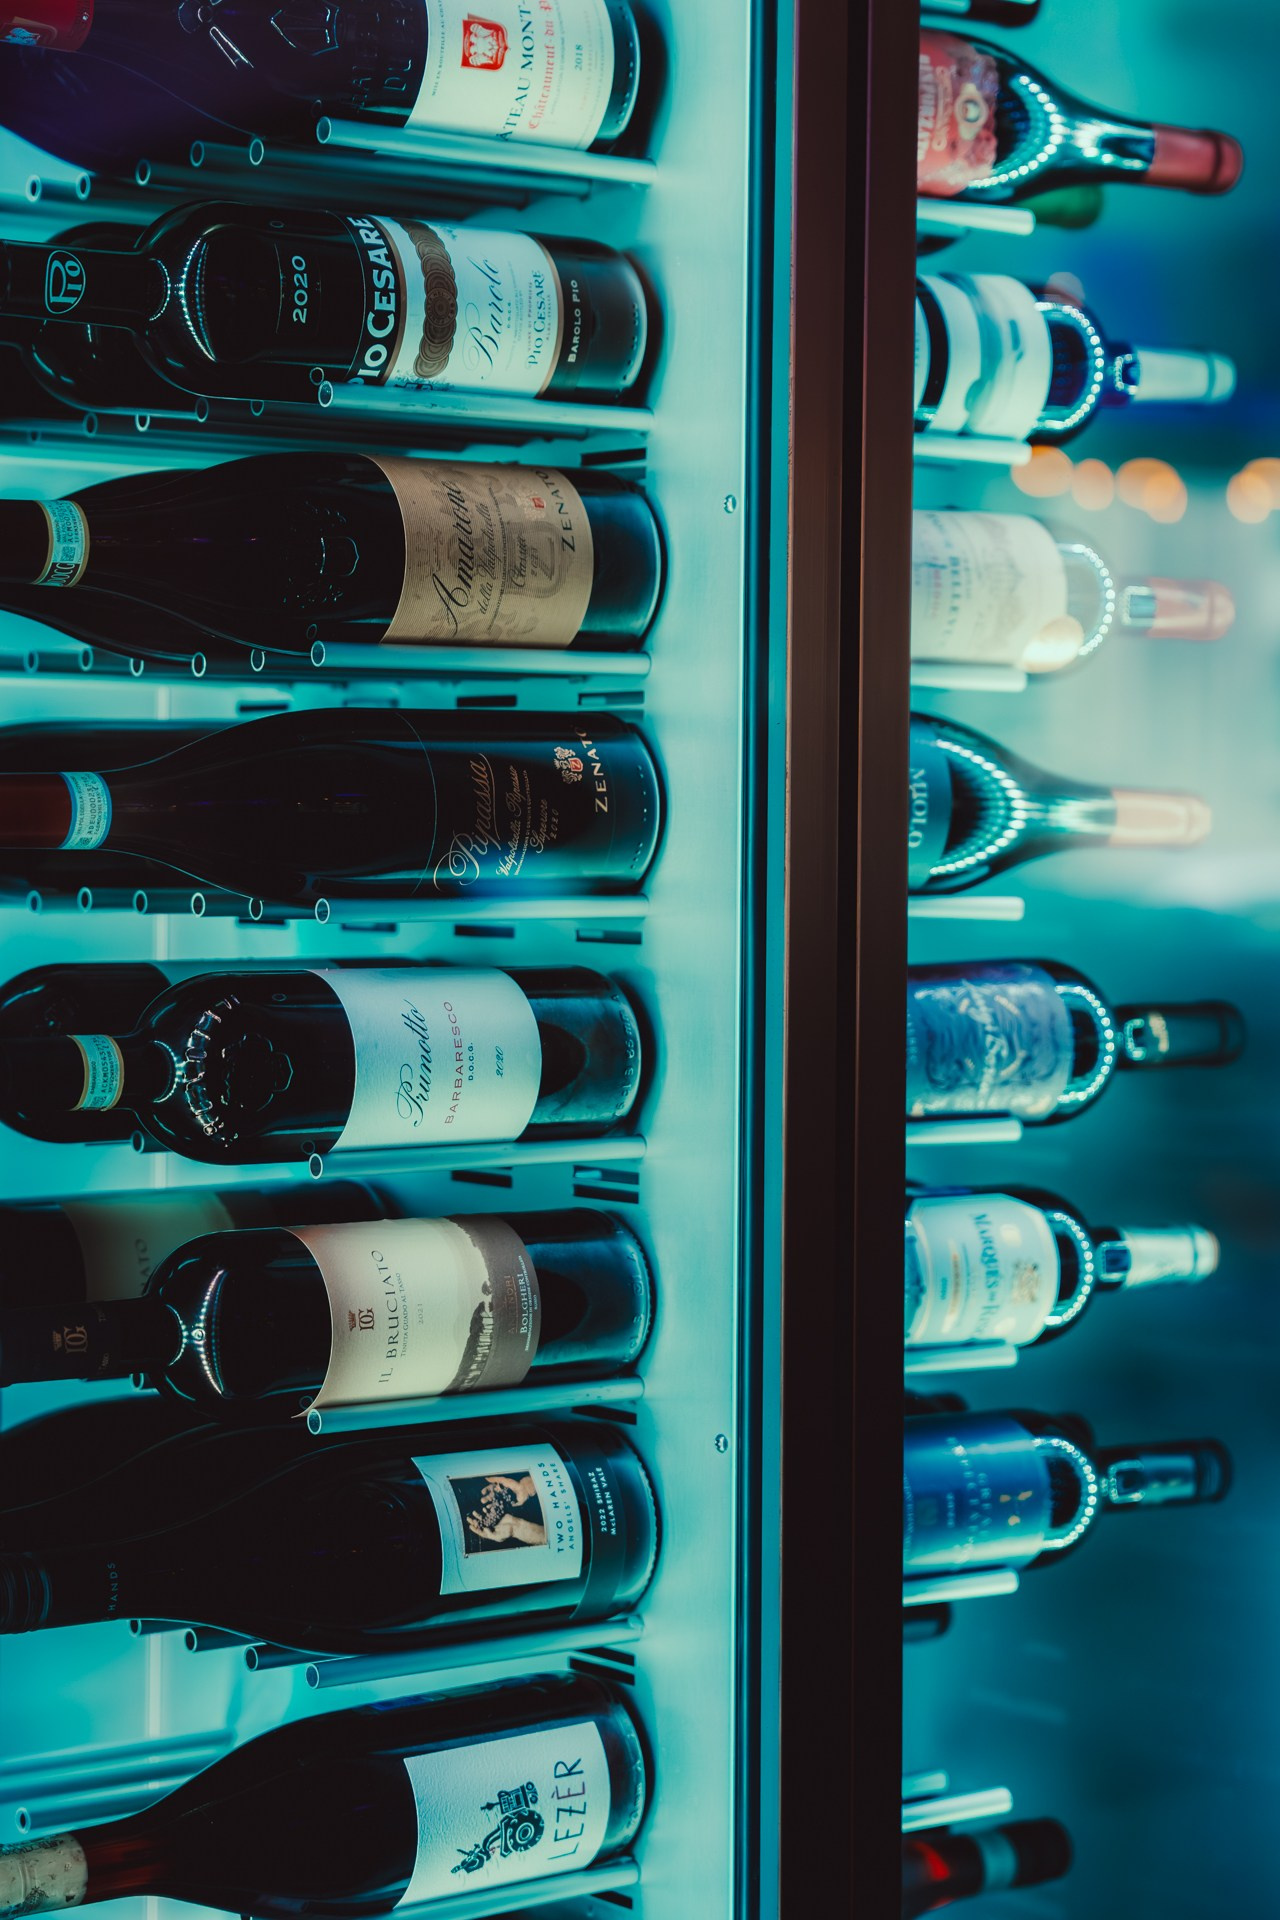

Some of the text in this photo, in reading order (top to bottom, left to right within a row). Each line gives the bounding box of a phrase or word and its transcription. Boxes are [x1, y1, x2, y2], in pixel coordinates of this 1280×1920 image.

[574, 43, 584, 71] 2018
[291, 255, 309, 324] 2020
[347, 217, 396, 338] CESARE
[462, 256, 503, 374] Barolo
[526, 270, 546, 367] PIO CESARE
[568, 279, 581, 363] BAROLO PIO
[535, 470, 575, 552] ZENATO
[432, 480, 474, 638] Amarone
[477, 583, 494, 614] della
[433, 753, 501, 891] Ripassa
[496, 765, 526, 876] Valpolicella Ripasso
[529, 798, 551, 854] Superiore
[394, 998, 432, 1128] Prunotto
[443, 1001, 464, 1124] BARBARESCO
[495, 1045, 504, 1078] 2020
[371, 1250, 399, 1383] IL BRUCIATO
[400, 1331, 409, 1357] TENUTA
[517, 1273, 529, 1334] BOLGHERI
[537, 1462, 565, 1553] TWO HANDS
[550, 1462, 575, 1550] ANGELS' SHARE
[587, 1471, 607, 1532] 2022 SHIRAZ
[596, 1466, 617, 1536] McLAREN VALE
[547, 1758, 587, 1861] LEZÈR
